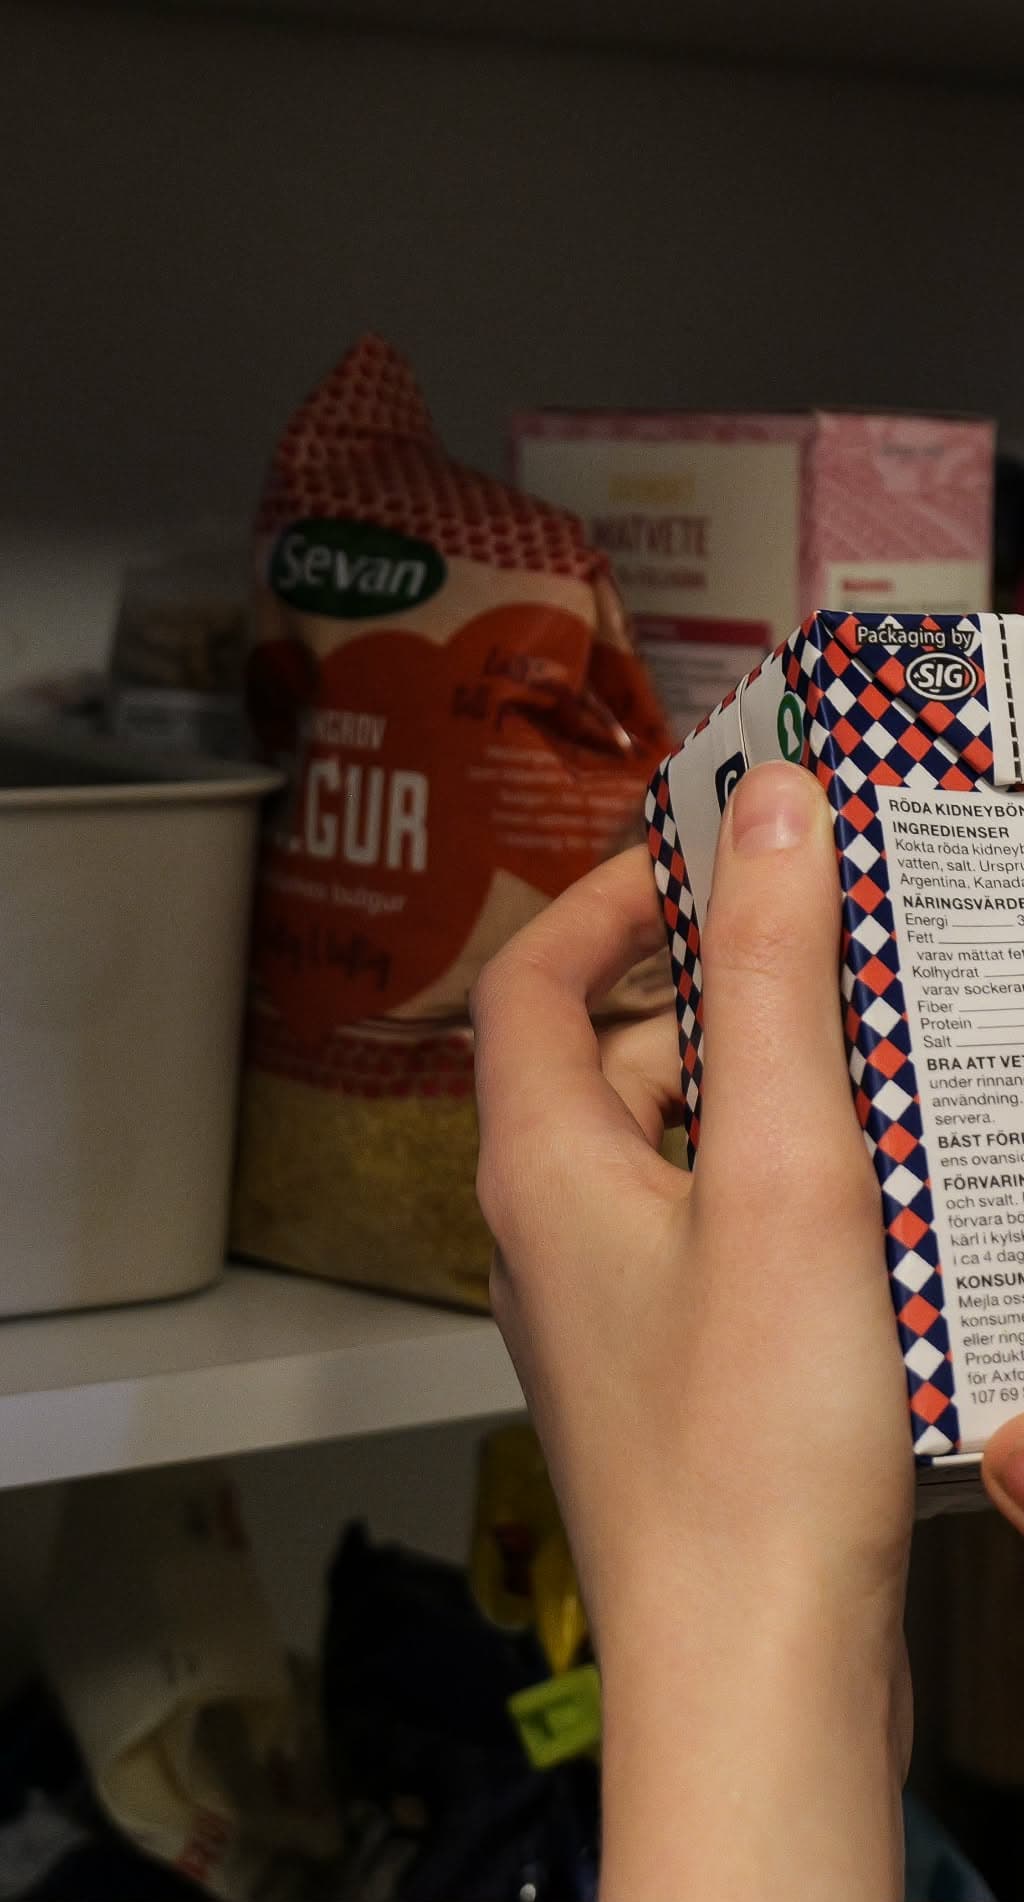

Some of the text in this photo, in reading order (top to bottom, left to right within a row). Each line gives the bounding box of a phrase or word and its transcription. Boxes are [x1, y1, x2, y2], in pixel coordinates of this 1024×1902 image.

[278, 533, 428, 598] Sevan
[858, 624, 972, 649] Packaging by
[918, 663, 962, 688] SIG
[889, 798, 932, 815] RÖDA
[893, 822, 1009, 838] INGREDIENSER
[895, 839, 934, 853] Kokta
[938, 842, 969, 855] röda
[898, 858, 943, 872] vatten,
[947, 860, 975, 872] salt.
[906, 914, 949, 929] Energi
[907, 931, 934, 943] Fett
[917, 951, 953, 961] varav
[958, 949, 1003, 961] mättat
[912, 966, 979, 981] Kolhydrat
[923, 985, 959, 995] varav
[917, 1000, 953, 1012] Fiber
[920, 1018, 972, 1030] Protein
[924, 1035, 951, 1048] Salt
[927, 1058, 962, 1071] BRA
[966, 1056, 995, 1070] ATT
[930, 1075, 972, 1088] under
[932, 1094, 1022, 1107] användning.
[935, 1112, 994, 1125] servera.
[938, 1134, 980, 1148] BÄST
[940, 1156, 968, 1167] ens
[946, 1196, 975, 1209] och
[979, 1195, 1018, 1207] svalt.
[948, 1215, 1003, 1228] förvara
[951, 1232, 979, 1247] kärl
[961, 1254, 980, 1264] ca
[984, 1252, 992, 1262] 4
[959, 1294, 1000, 1309] Mejla
[963, 1334, 994, 1346] eller
[968, 1371, 987, 1385] för
[971, 1391, 995, 1404] 107
[1000, 1388, 1018, 1400] 69
